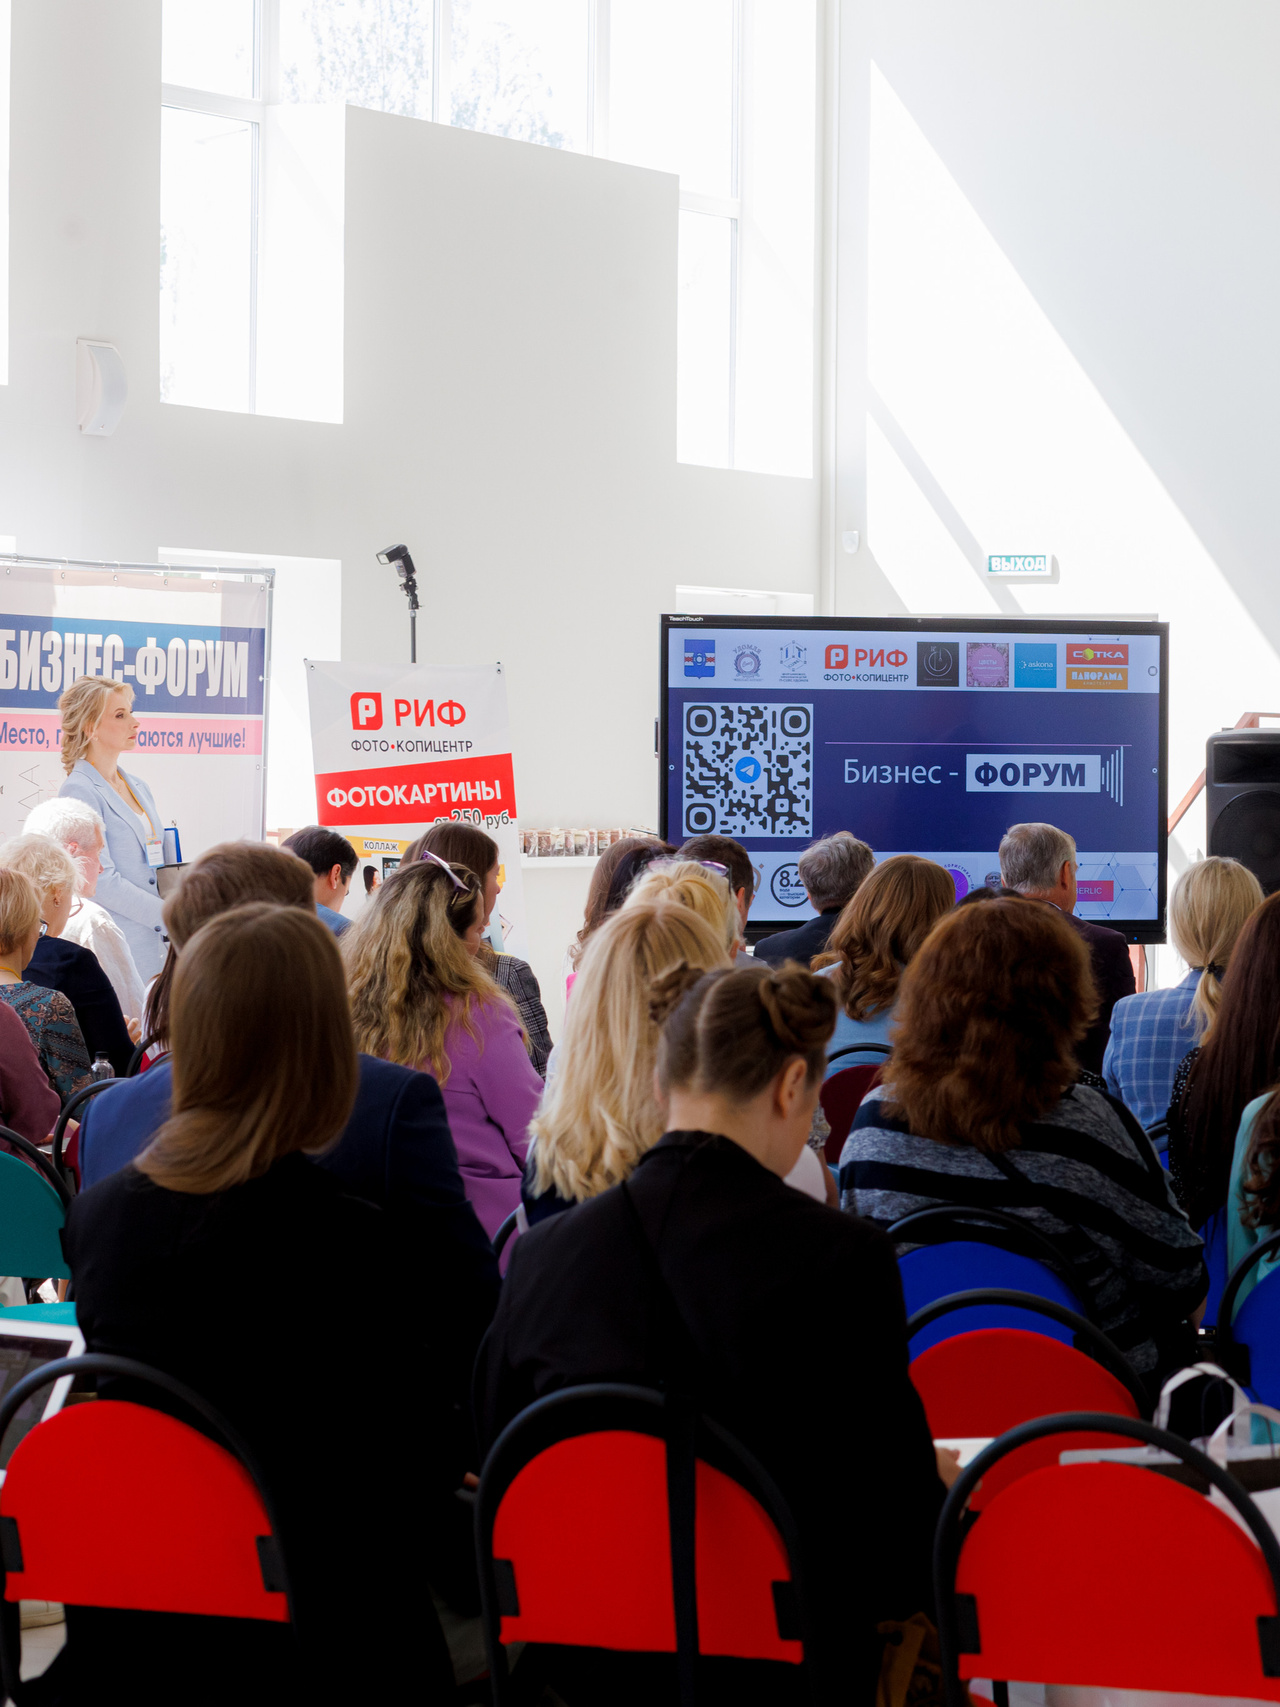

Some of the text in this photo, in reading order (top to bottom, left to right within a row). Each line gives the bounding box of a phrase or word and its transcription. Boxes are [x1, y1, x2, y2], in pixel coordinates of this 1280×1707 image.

[991, 557, 1046, 571] ВЫХОД
[733, 644, 762, 654] УДОМЛЯ
[855, 649, 908, 667] РИФ
[0, 629, 248, 697] БИЗНЕС-ФОРУМ
[1028, 660, 1054, 668] askona
[1071, 672, 1124, 681] ПАНОРАМА
[394, 698, 467, 727] РИФ
[188, 728, 246, 753] лучшие!
[843, 758, 942, 784] Бизнес
[974, 762, 1086, 787] ФОРУМ
[326, 780, 502, 807] ФОТОКАРТИНЫ
[452, 809, 482, 826] 250
[485, 811, 514, 829] руб.
[363, 840, 399, 852] КОЛЛАЖ
[779, 870, 805, 888] 8.2
